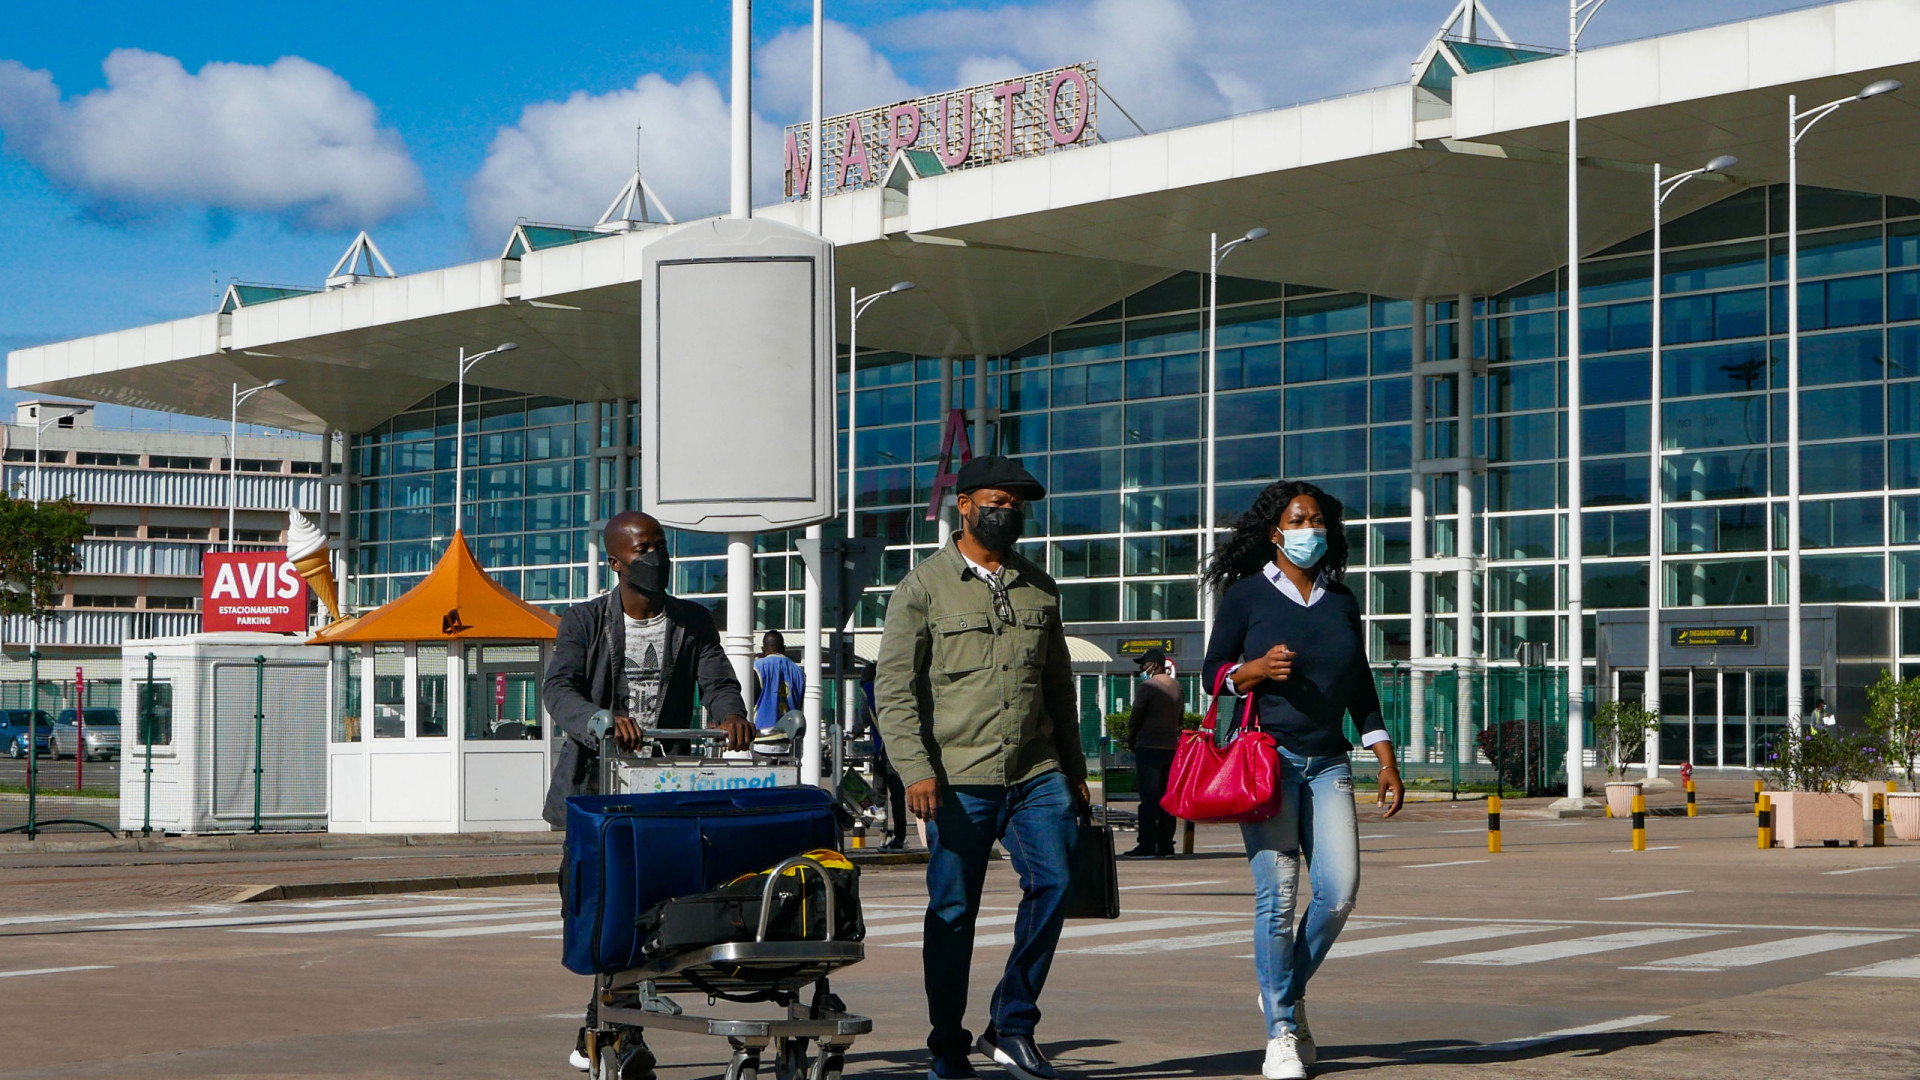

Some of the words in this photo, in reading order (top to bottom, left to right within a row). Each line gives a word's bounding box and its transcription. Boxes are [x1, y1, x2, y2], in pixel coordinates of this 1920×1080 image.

[785, 70, 1088, 195] MAPUTO
[210, 561, 300, 599] AVIS
[219, 606, 289, 614] ESTACIONAMENTO
[237, 617, 271, 625] PARKING
[1740, 629, 1747, 642] 4
[1166, 640, 1172, 652] 3
